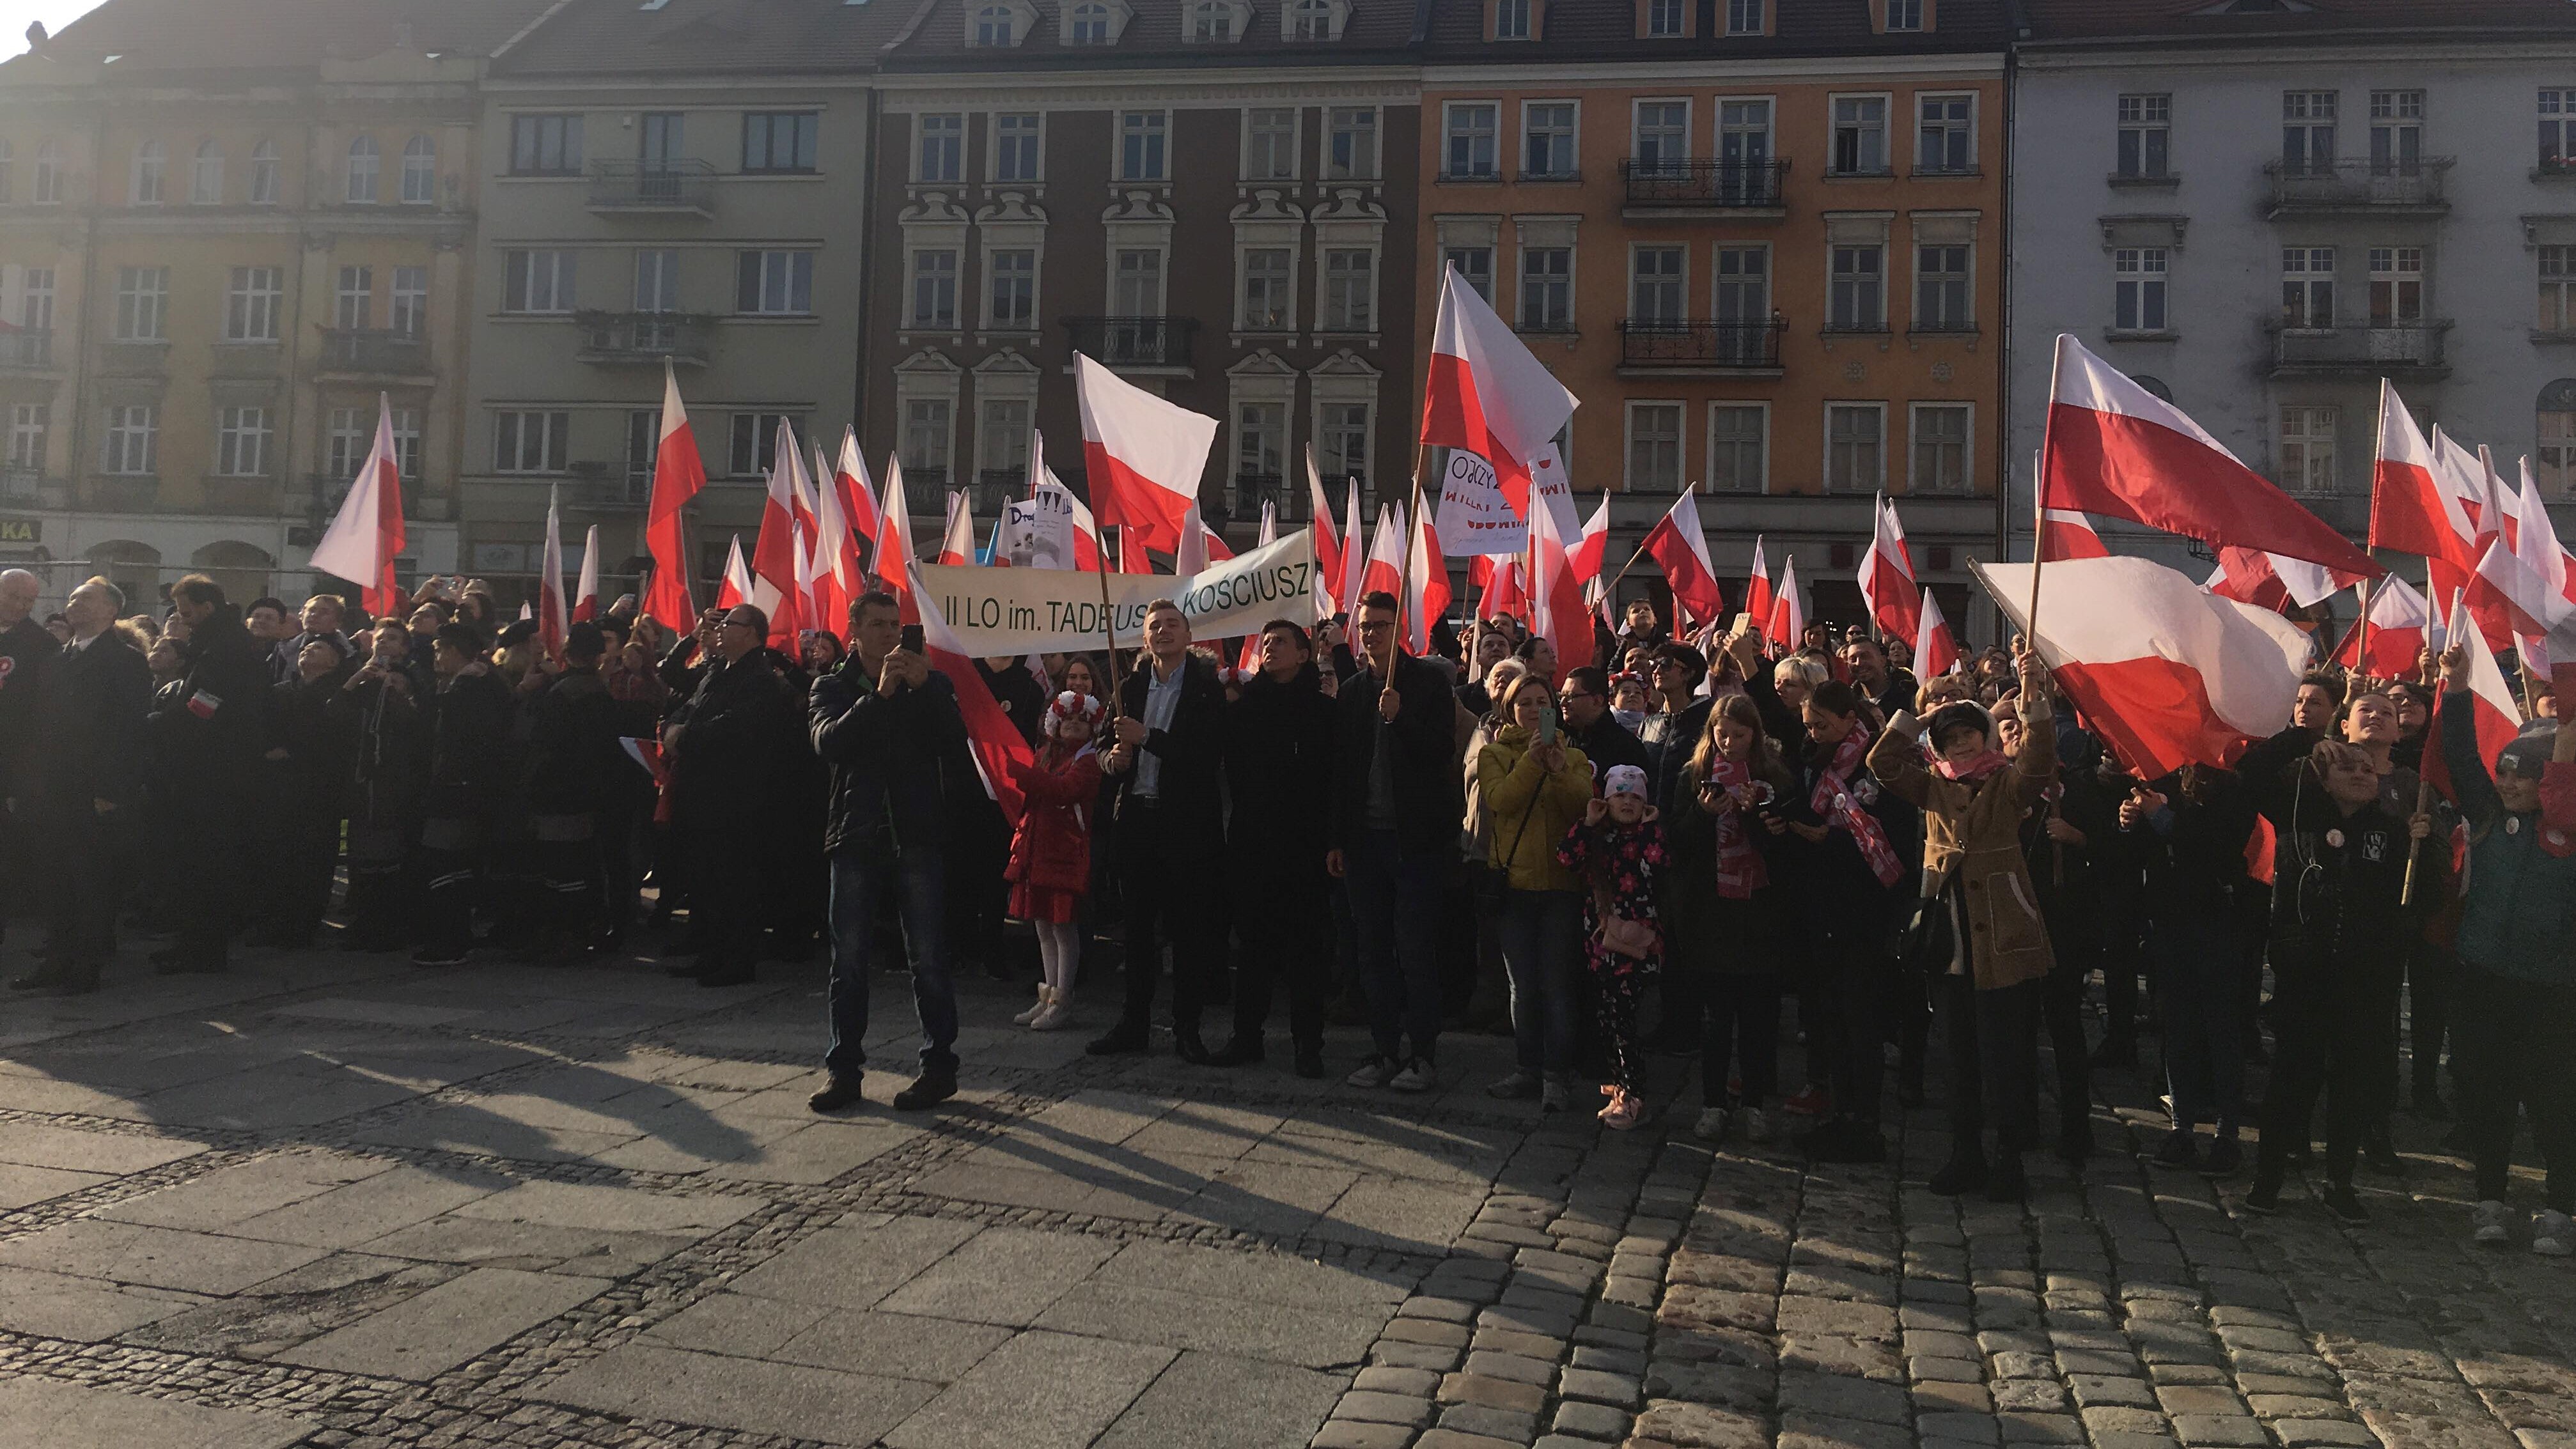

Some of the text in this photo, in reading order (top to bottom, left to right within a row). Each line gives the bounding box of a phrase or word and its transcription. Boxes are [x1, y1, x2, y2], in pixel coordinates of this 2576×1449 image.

[946, 595, 957, 626] II
[967, 596, 1001, 629] LO
[1008, 598, 1042, 632] im.
[1046, 598, 1174, 633] TADEUS
